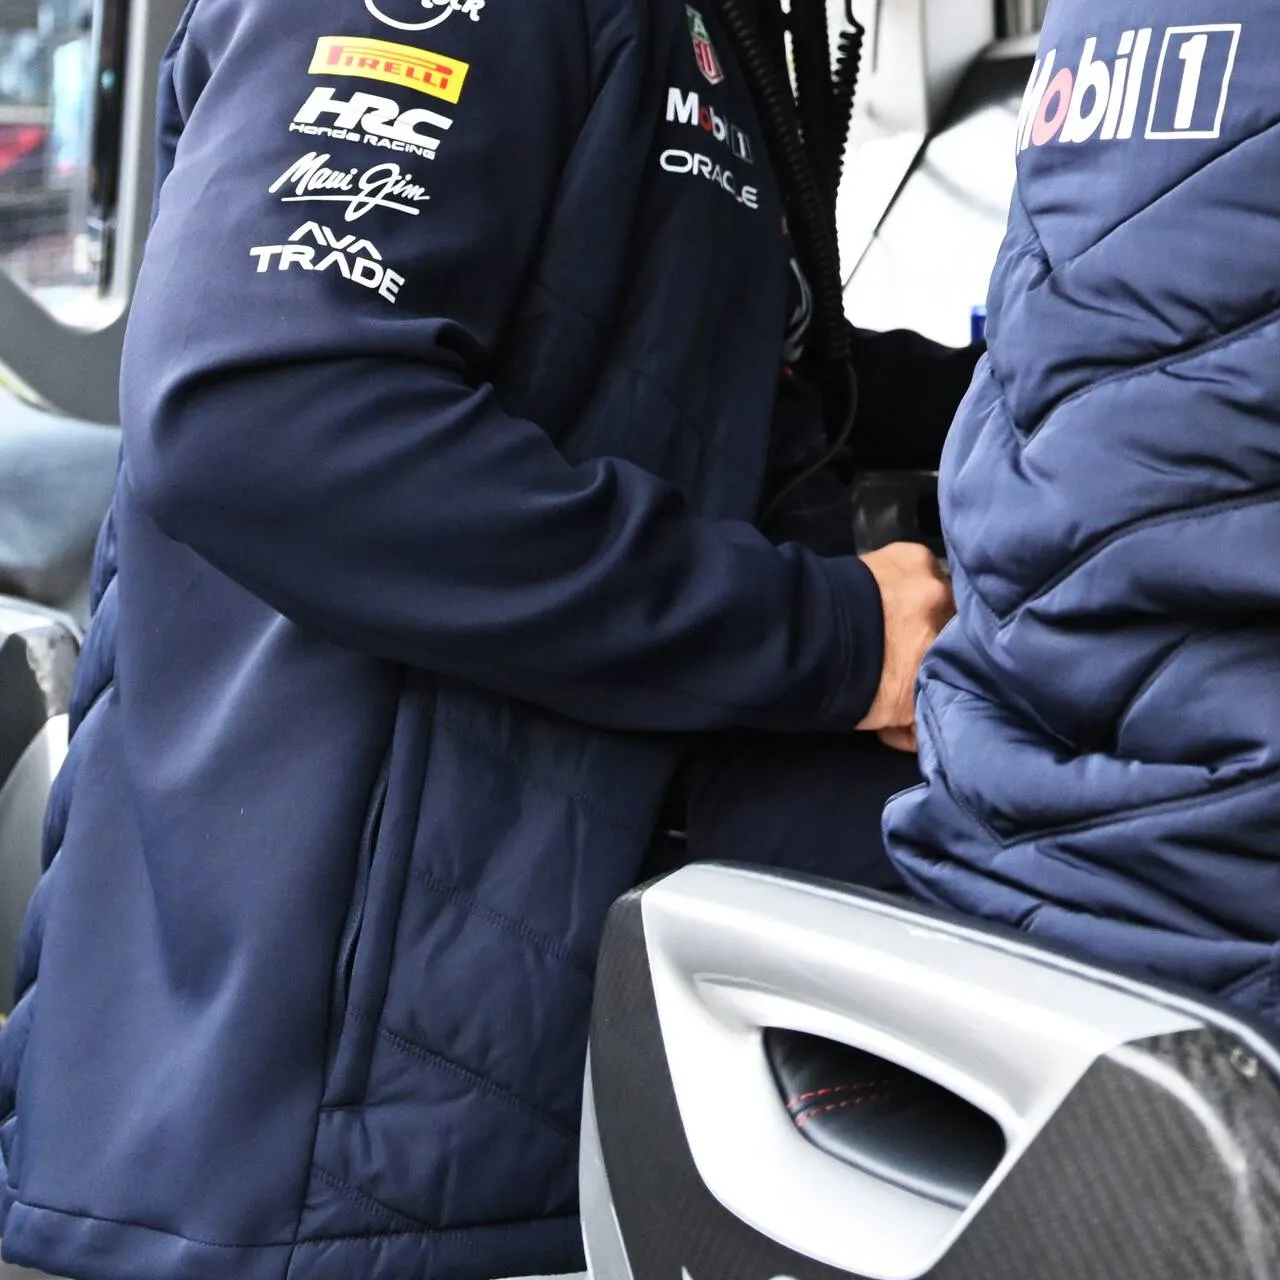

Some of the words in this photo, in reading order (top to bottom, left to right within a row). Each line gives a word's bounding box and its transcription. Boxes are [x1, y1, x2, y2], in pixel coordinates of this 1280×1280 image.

[326, 45, 453, 91] PIRELLI
[1017, 28, 1152, 156] Mobil
[289, 122, 361, 142] Honda
[363, 134, 436, 160] RACING
[293, 87, 453, 150] HRC
[269, 152, 358, 195] Maui
[344, 163, 430, 221] Jim
[288, 221, 383, 261] AVA
[250, 244, 405, 304] TRADE
